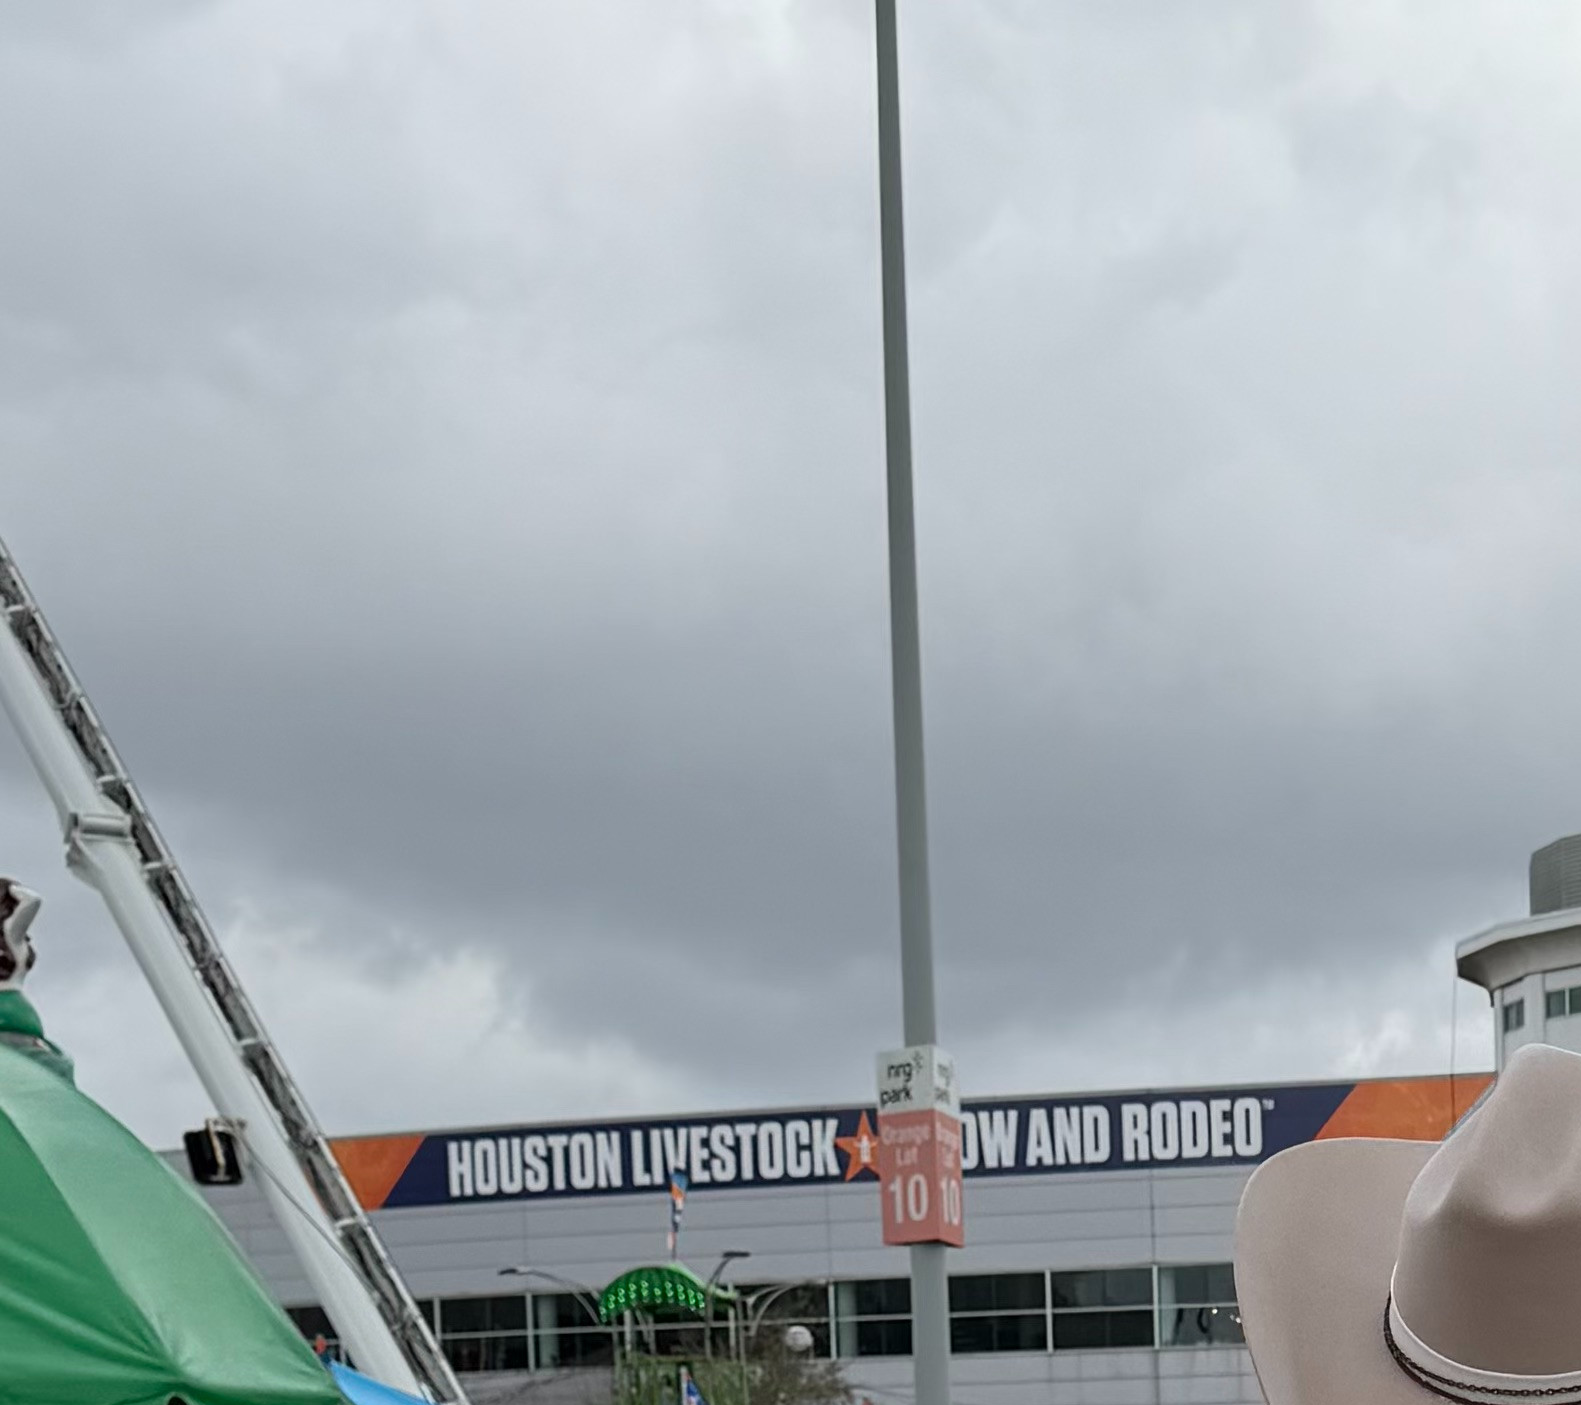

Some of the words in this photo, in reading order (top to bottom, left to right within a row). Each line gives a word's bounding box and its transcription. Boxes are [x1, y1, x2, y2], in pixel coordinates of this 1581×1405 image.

[887, 1062, 912, 1083] nrg
[880, 1087, 912, 1107] park
[447, 1131, 623, 1198] HOUSTON
[630, 1118, 840, 1187] LIVESTOCK
[960, 1109, 1018, 1170] OW
[1025, 1105, 1111, 1166] AND
[1121, 1098, 1263, 1162] RODEO
[895, 1146, 918, 1166] Lot
[889, 1173, 929, 1224] 10
[940, 1178, 961, 1226] 10
